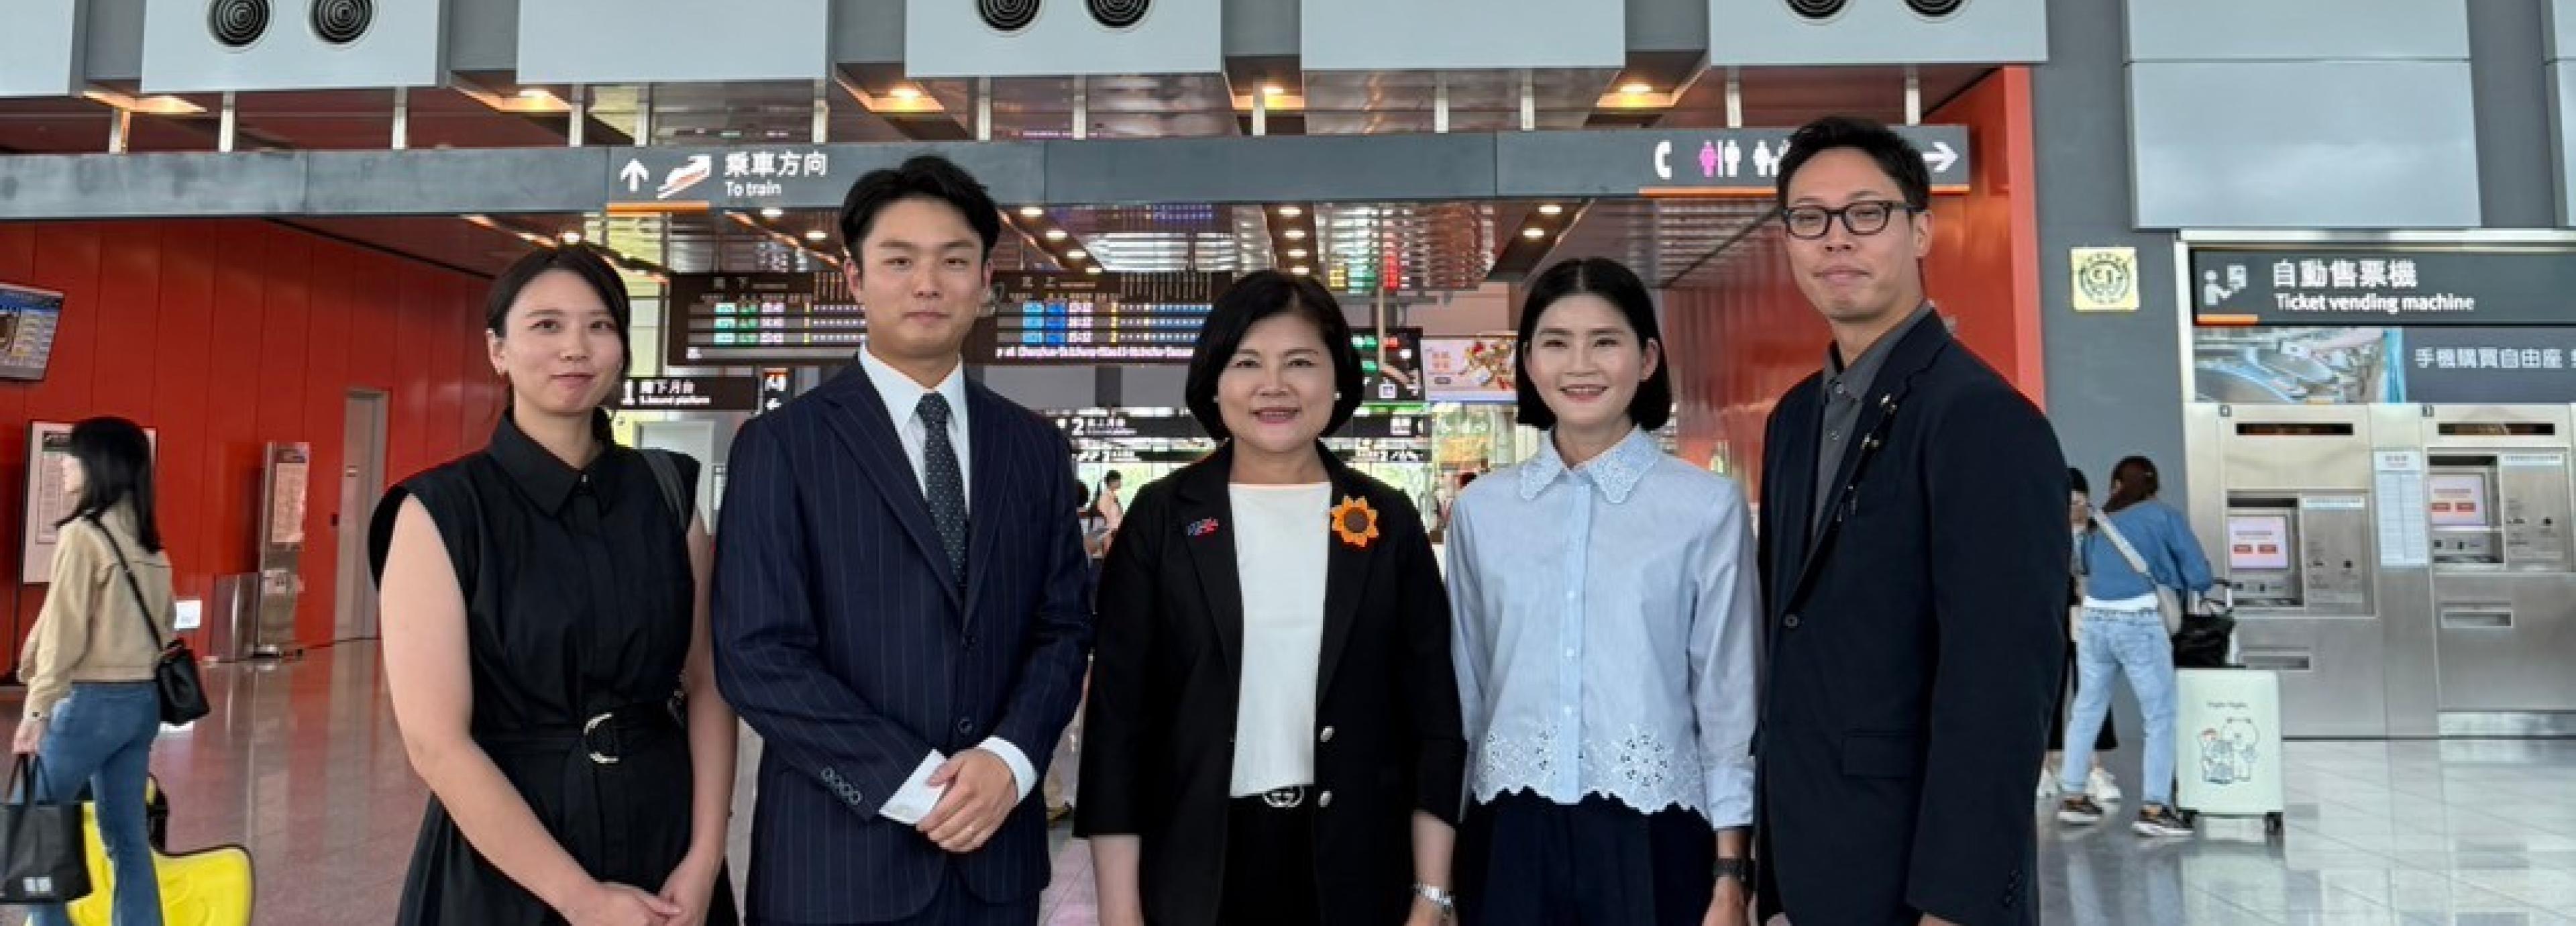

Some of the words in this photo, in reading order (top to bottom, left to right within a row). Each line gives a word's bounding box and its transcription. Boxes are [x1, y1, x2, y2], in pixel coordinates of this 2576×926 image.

[724, 150, 828, 177] 乘車方向
[725, 181, 744, 197] To
[746, 181, 782, 197] train
[2273, 259, 2418, 289] 自動售票機
[2274, 293, 2326, 311] Ticket
[2329, 293, 2400, 315] vending
[2401, 293, 2475, 311] machine
[2414, 347, 2563, 368] 手機購買自由座
[621, 378, 636, 405] 1
[1071, 417, 1084, 435] 2
